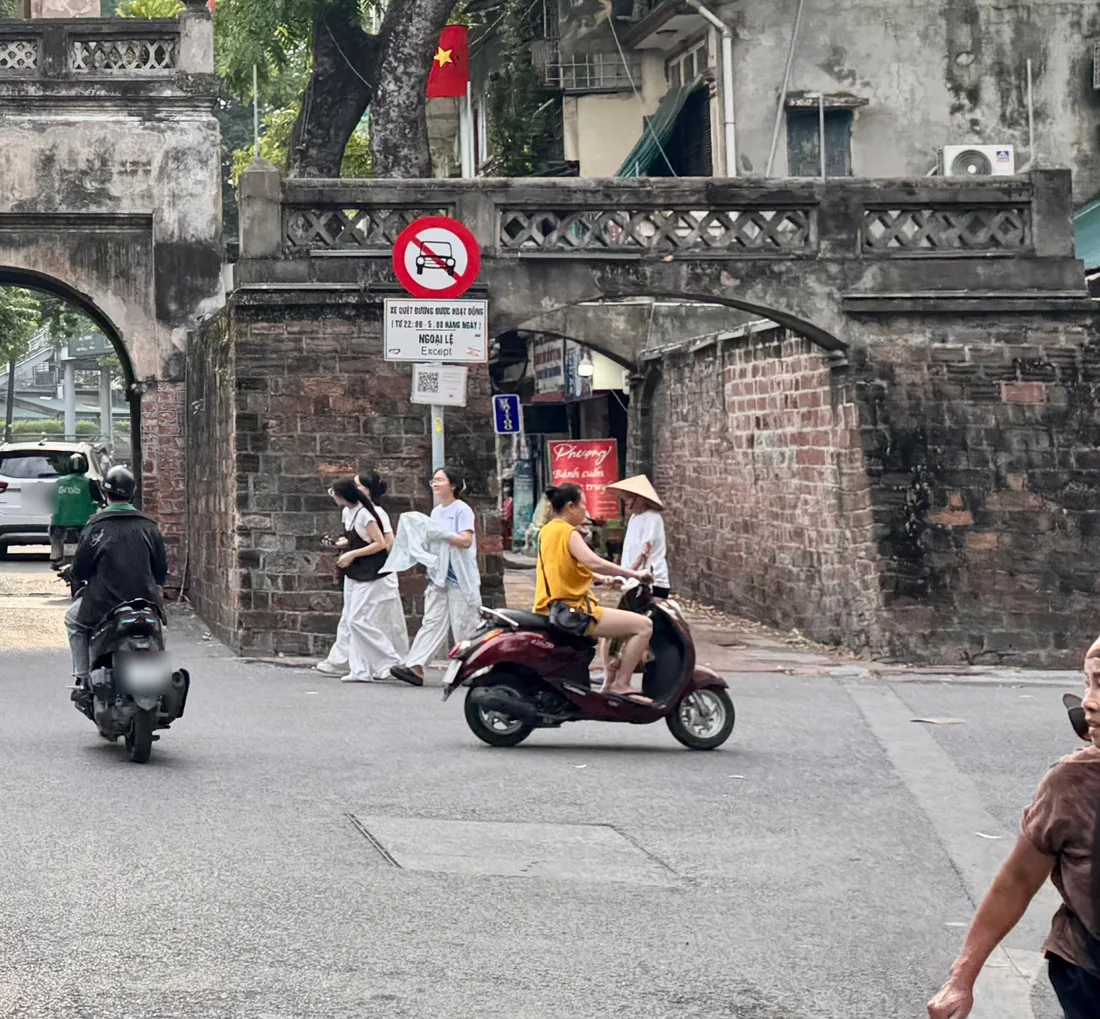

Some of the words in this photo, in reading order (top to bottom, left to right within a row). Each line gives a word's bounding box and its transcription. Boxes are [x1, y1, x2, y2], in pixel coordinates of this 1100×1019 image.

[418, 334, 443, 346] NGOẠI
[421, 346, 452, 357] Except
[58, 485, 81, 495] Grab
